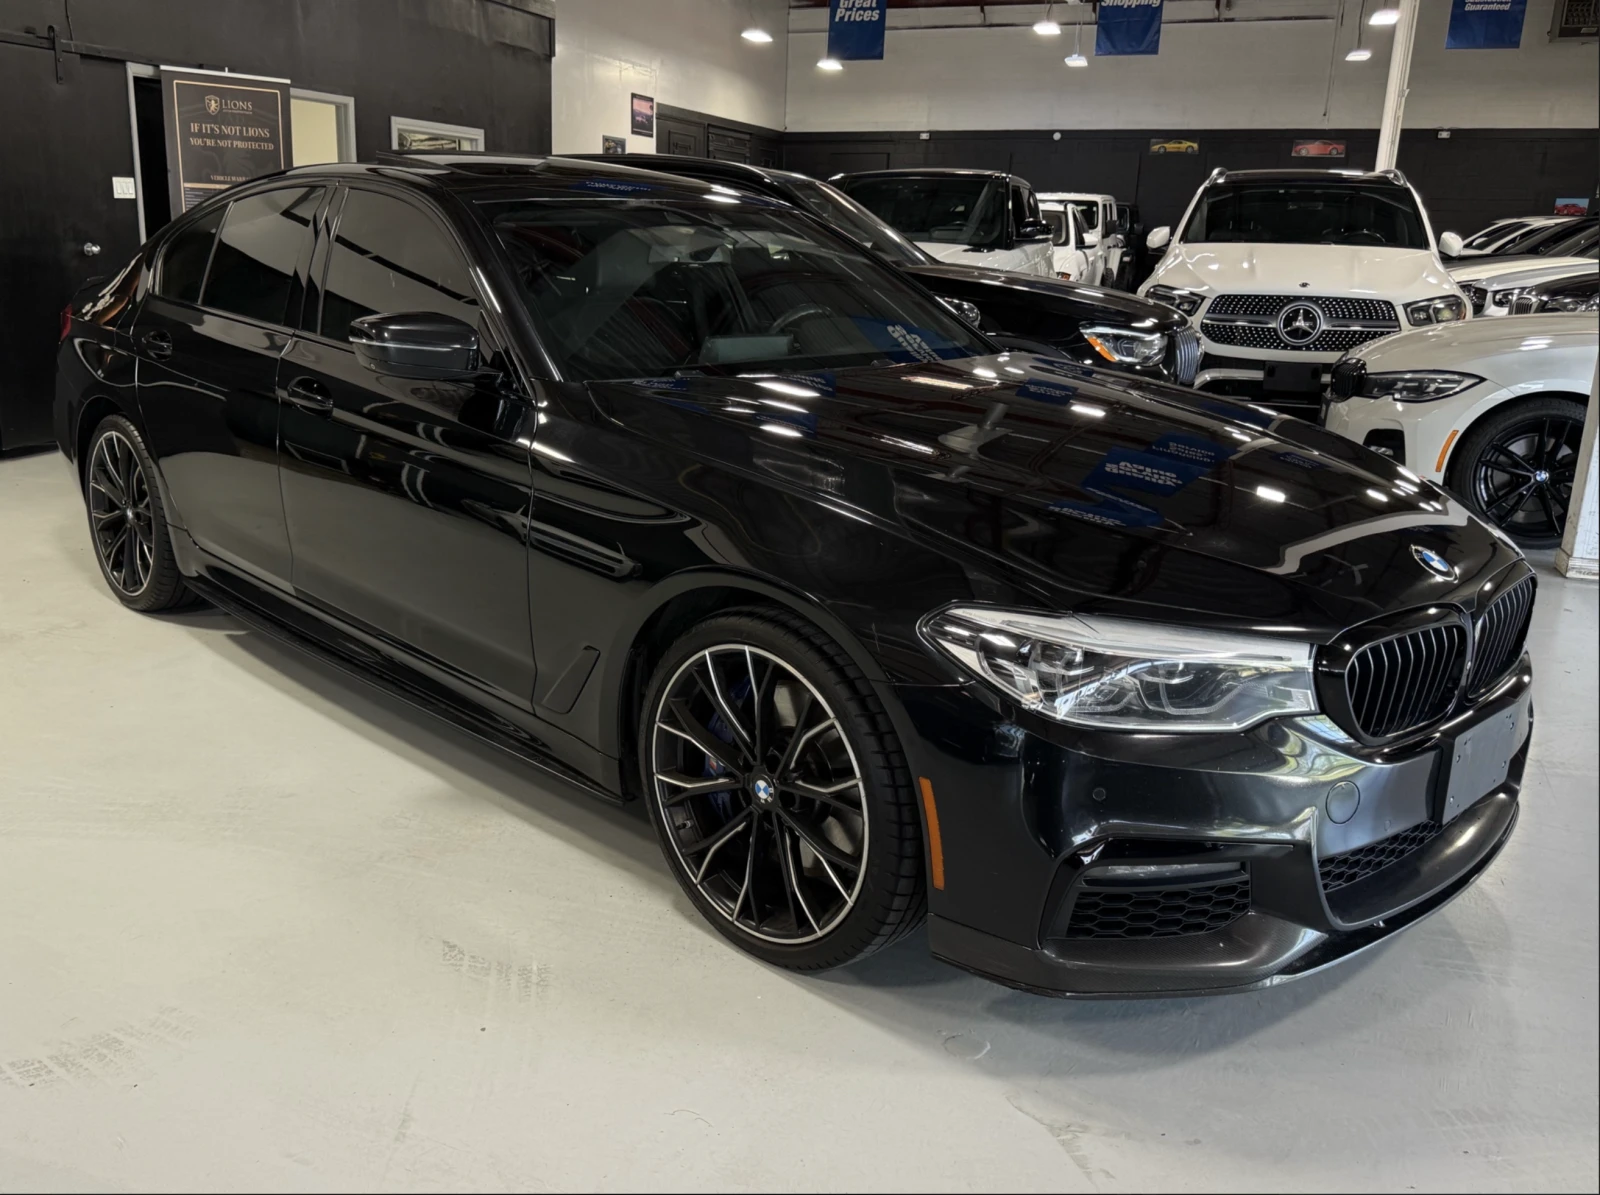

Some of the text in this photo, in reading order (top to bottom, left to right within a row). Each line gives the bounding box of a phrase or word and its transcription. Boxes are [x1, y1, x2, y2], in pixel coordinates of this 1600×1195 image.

[839, 0, 877, 8] Great
[1464, 3, 1511, 11] Guaranteed
[835, 8, 880, 22] Prices
[222, 99, 253, 111] LIONS
[190, 123, 270, 138] IF IT'S NOT LIONS
[189, 137, 274, 151] YOU'RE NOT PROTECTED
